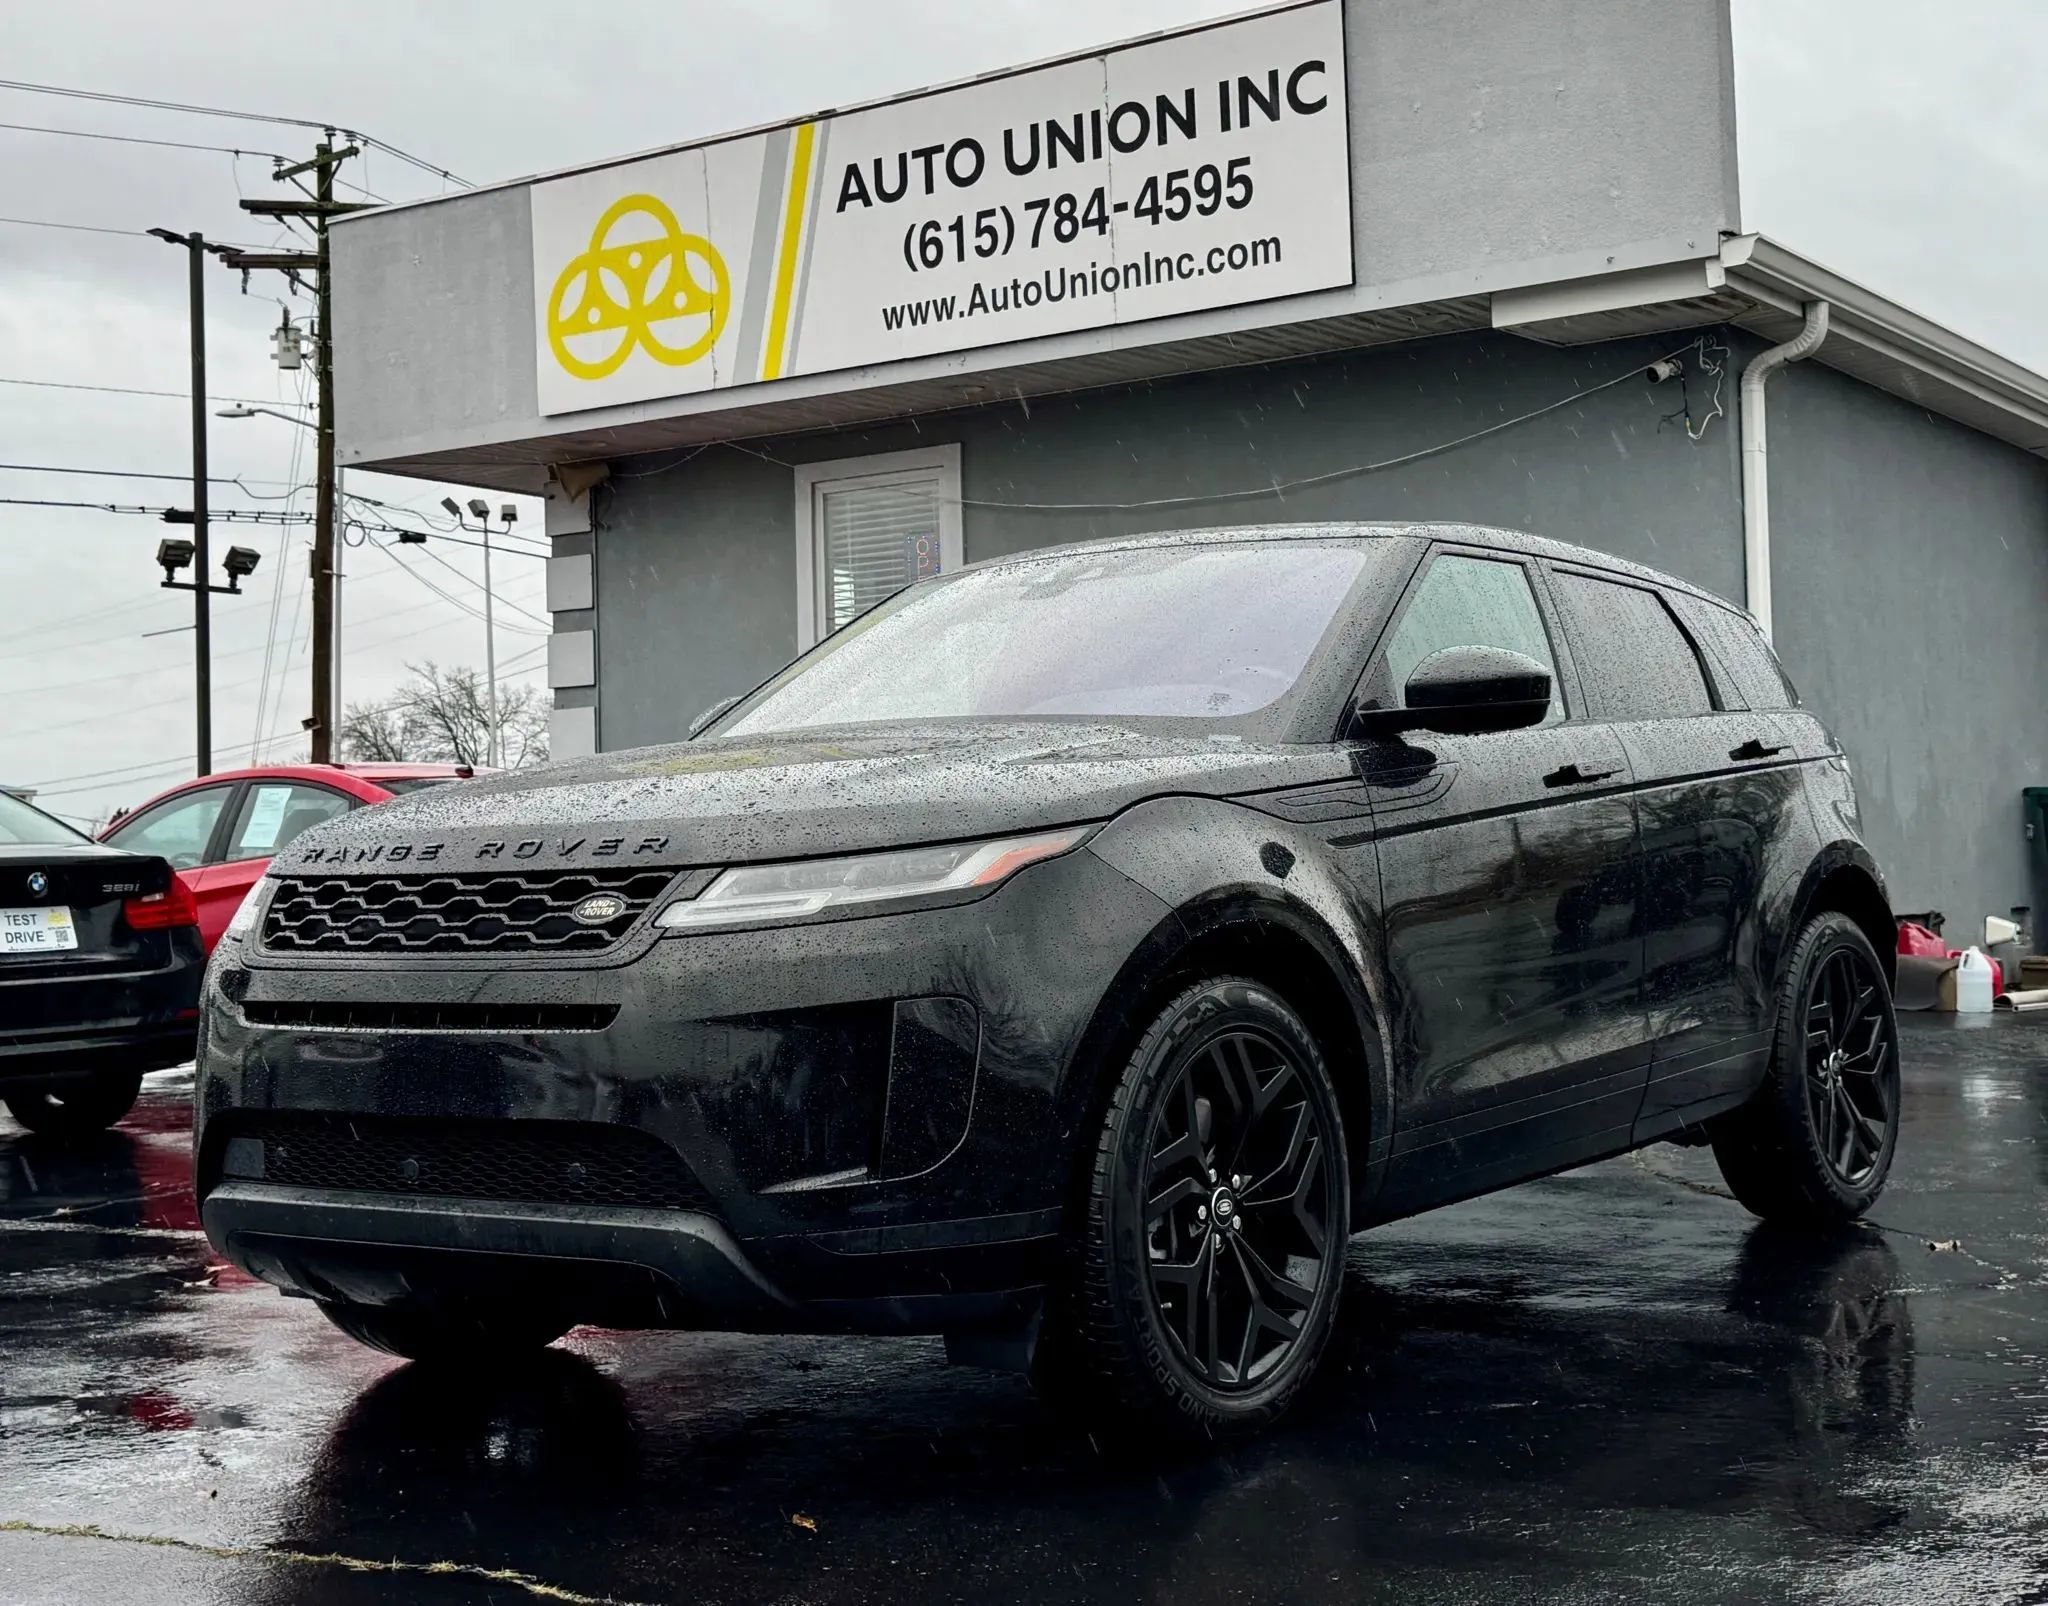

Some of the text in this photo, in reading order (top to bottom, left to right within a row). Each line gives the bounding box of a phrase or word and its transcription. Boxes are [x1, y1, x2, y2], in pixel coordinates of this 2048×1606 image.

[836, 60, 1328, 214] AUTO UNION INC
[903, 156, 1254, 273] (615) 784-4595
[882, 236, 1282, 332] www.AutoUnionInc.com
[301, 836, 670, 864] RANGE ROVER
[4, 913, 38, 926] TEST
[5, 930, 46, 944] DRIVE
